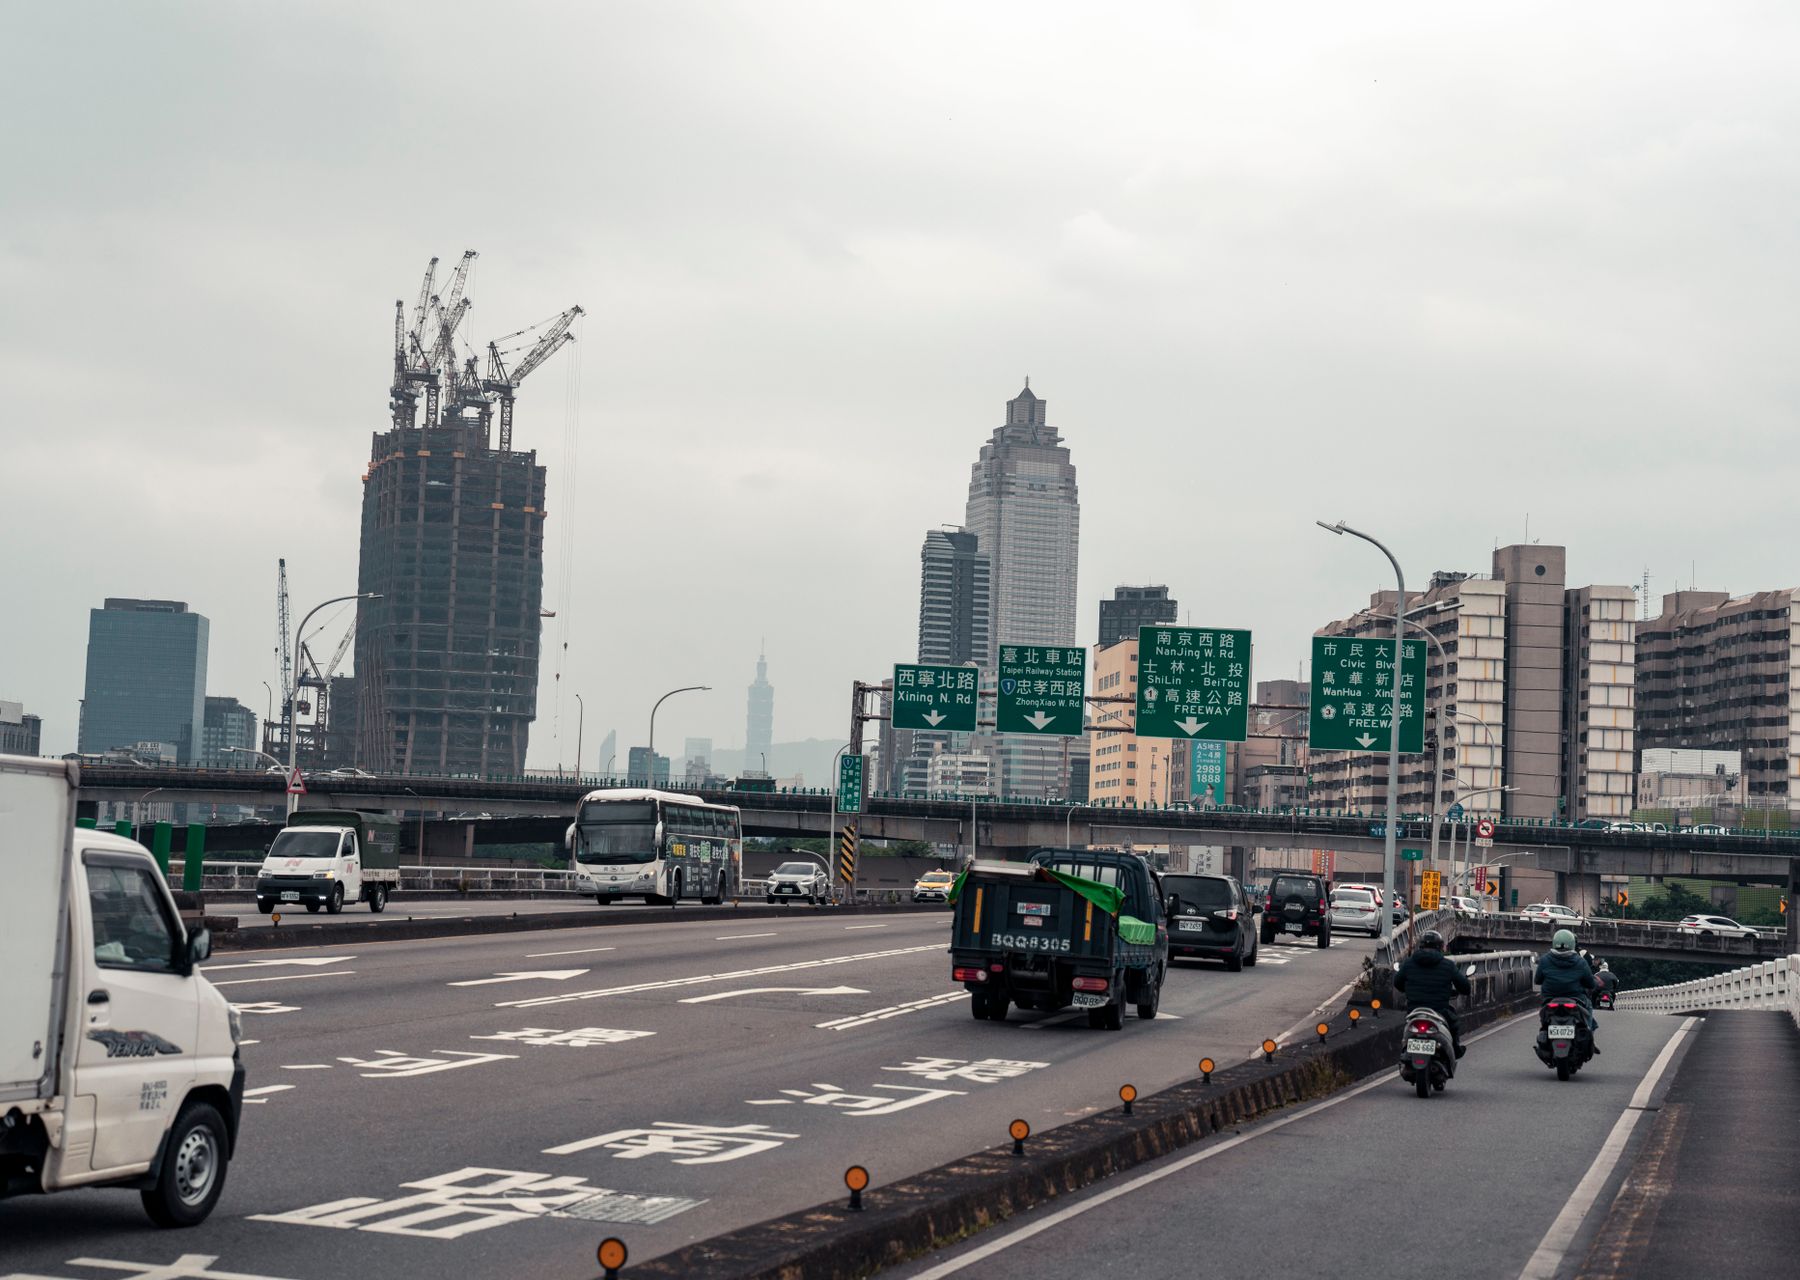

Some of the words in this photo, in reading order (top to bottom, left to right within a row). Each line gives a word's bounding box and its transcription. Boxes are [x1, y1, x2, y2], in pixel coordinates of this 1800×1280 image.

[1157, 631, 1234, 648] 南京西路
[1002, 648, 1082, 666] 臺北車站
[1156, 647, 1200, 659] NanJing
[1204, 649, 1215, 658] W.
[1220, 649, 1236, 659] Rd.
[1324, 643, 1415, 659] 市民大道
[1340, 659, 1366, 669] Civic
[1002, 666, 1024, 675] Taipei
[1026, 667, 1053, 677] Railway
[1056, 668, 1082, 677] Station
[898, 669, 975, 690] 西寧北路
[1147, 675, 1182, 685] ShiLin
[1203, 678, 1240, 688] BeiTou
[1017, 680, 1082, 697] 忠孝西路
[1323, 687, 1362, 697] WanHua
[898, 691, 933, 705] Xining
[940, 693, 950, 703] N.
[957, 694, 973, 704] Rd.
[1016, 698, 1056, 709] ZhongXiao
[1069, 700, 1081, 708] Rd.
[1165, 688, 1243, 706] 高速公路
[1174, 705, 1232, 716] FREEWAY
[1343, 702, 1413, 718] 高速公路
[1196, 765, 1221, 774] 2989
[1197, 774, 1221, 783] 1888
